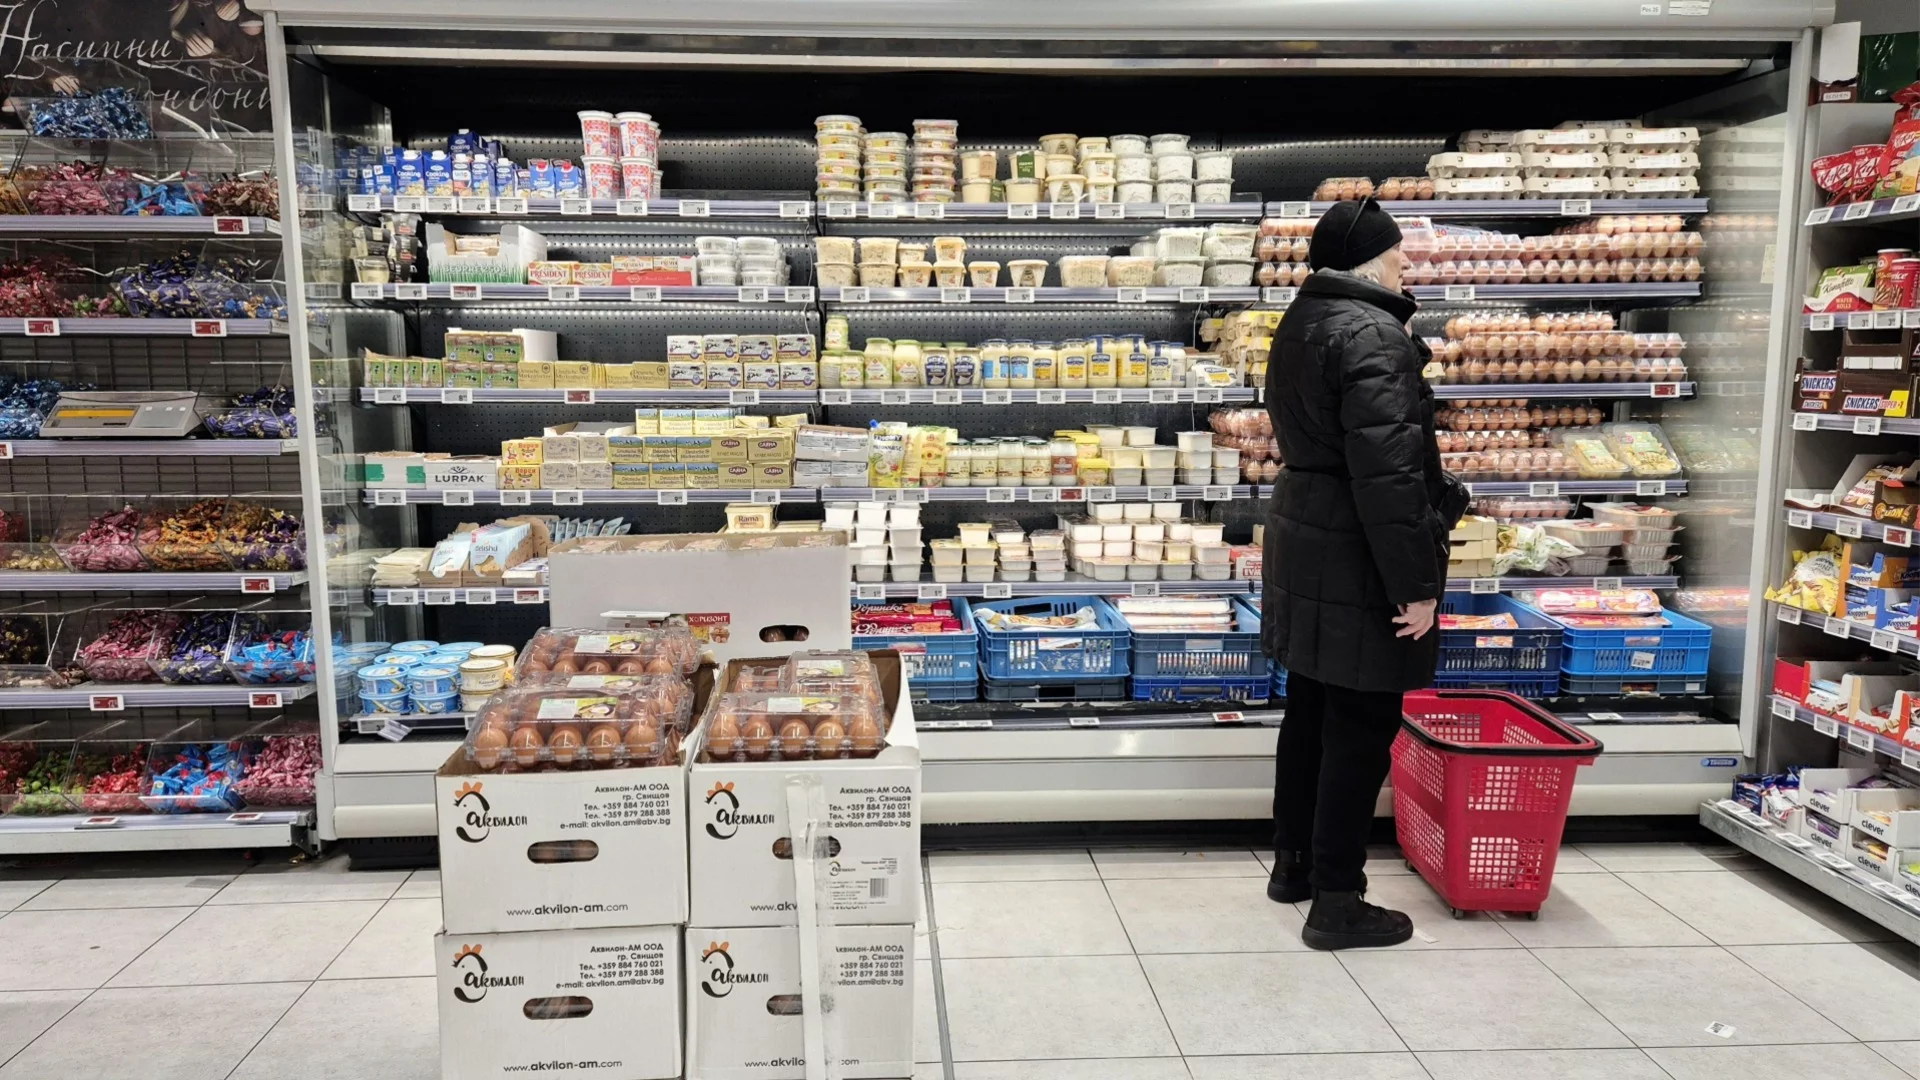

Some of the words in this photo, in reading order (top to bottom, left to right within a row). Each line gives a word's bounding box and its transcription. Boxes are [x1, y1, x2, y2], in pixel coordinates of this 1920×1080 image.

[0, 0, 173, 79] Насипни
[1801, 377, 1836, 390] SNICKERS
[1845, 397, 1880, 409] SNICKERS
[435, 475, 485, 483] LURPAK
[738, 514, 760, 523] Rama
[1851, 575, 1873, 583] Knoppers
[595, 784, 647, 793] Аквилон-АМ
[649, 783, 670, 791] ООД
[840, 786, 890, 794] Аквилон-АМ
[891, 786, 912, 794] ООД
[636, 792, 670, 800] Свищов
[584, 803, 600, 811] Тел.
[602, 802, 621, 810] +359
[623, 801, 638, 809] 884
[640, 800, 654, 808] 760
[655, 800, 669, 808] 021
[846, 803, 865, 811] +359
[1810, 798, 1830, 813] clever
[585, 812, 600, 820] Тел.
[602, 811, 621, 819] +359
[623, 810, 639, 818] 879
[640, 809, 655, 817] 288
[656, 808, 671, 816] 388
[882, 811, 896, 819] 288
[897, 811, 911, 819] 388
[560, 820, 589, 829] e-mail:
[591, 818, 671, 829] akvilon.am@abv.bg
[834, 821, 912, 829] akvilon.am@abv.bg
[1862, 819, 1884, 836] clever
[1811, 833, 1832, 848] clever
[1857, 855, 1880, 873] clever
[506, 902, 629, 917] www.akvilon-am.com
[590, 945, 642, 953] Аквилон-АМ
[643, 943, 664, 951] ООД
[885, 945, 904, 953] ООД
[630, 952, 664, 960] Свищов
[579, 963, 595, 971] Тел.
[597, 962, 616, 970] +359
[618, 961, 633, 969] 884
[635, 960, 649, 968] 760
[650, 960, 664, 968] 021
[875, 961, 889, 969] 760
[579, 972, 596, 980] Тел.
[597, 971, 616, 979] +359
[618, 970, 633, 978] 879
[650, 969, 664, 977] 388
[840, 970, 858, 978] +359
[555, 980, 584, 989] e-mail:
[585, 977, 665, 989] akvilon.am@abv.bg
[837, 978, 904, 986] vilon.am@abv.bg
[503, 1059, 622, 1073] www.akvilon-am.com
